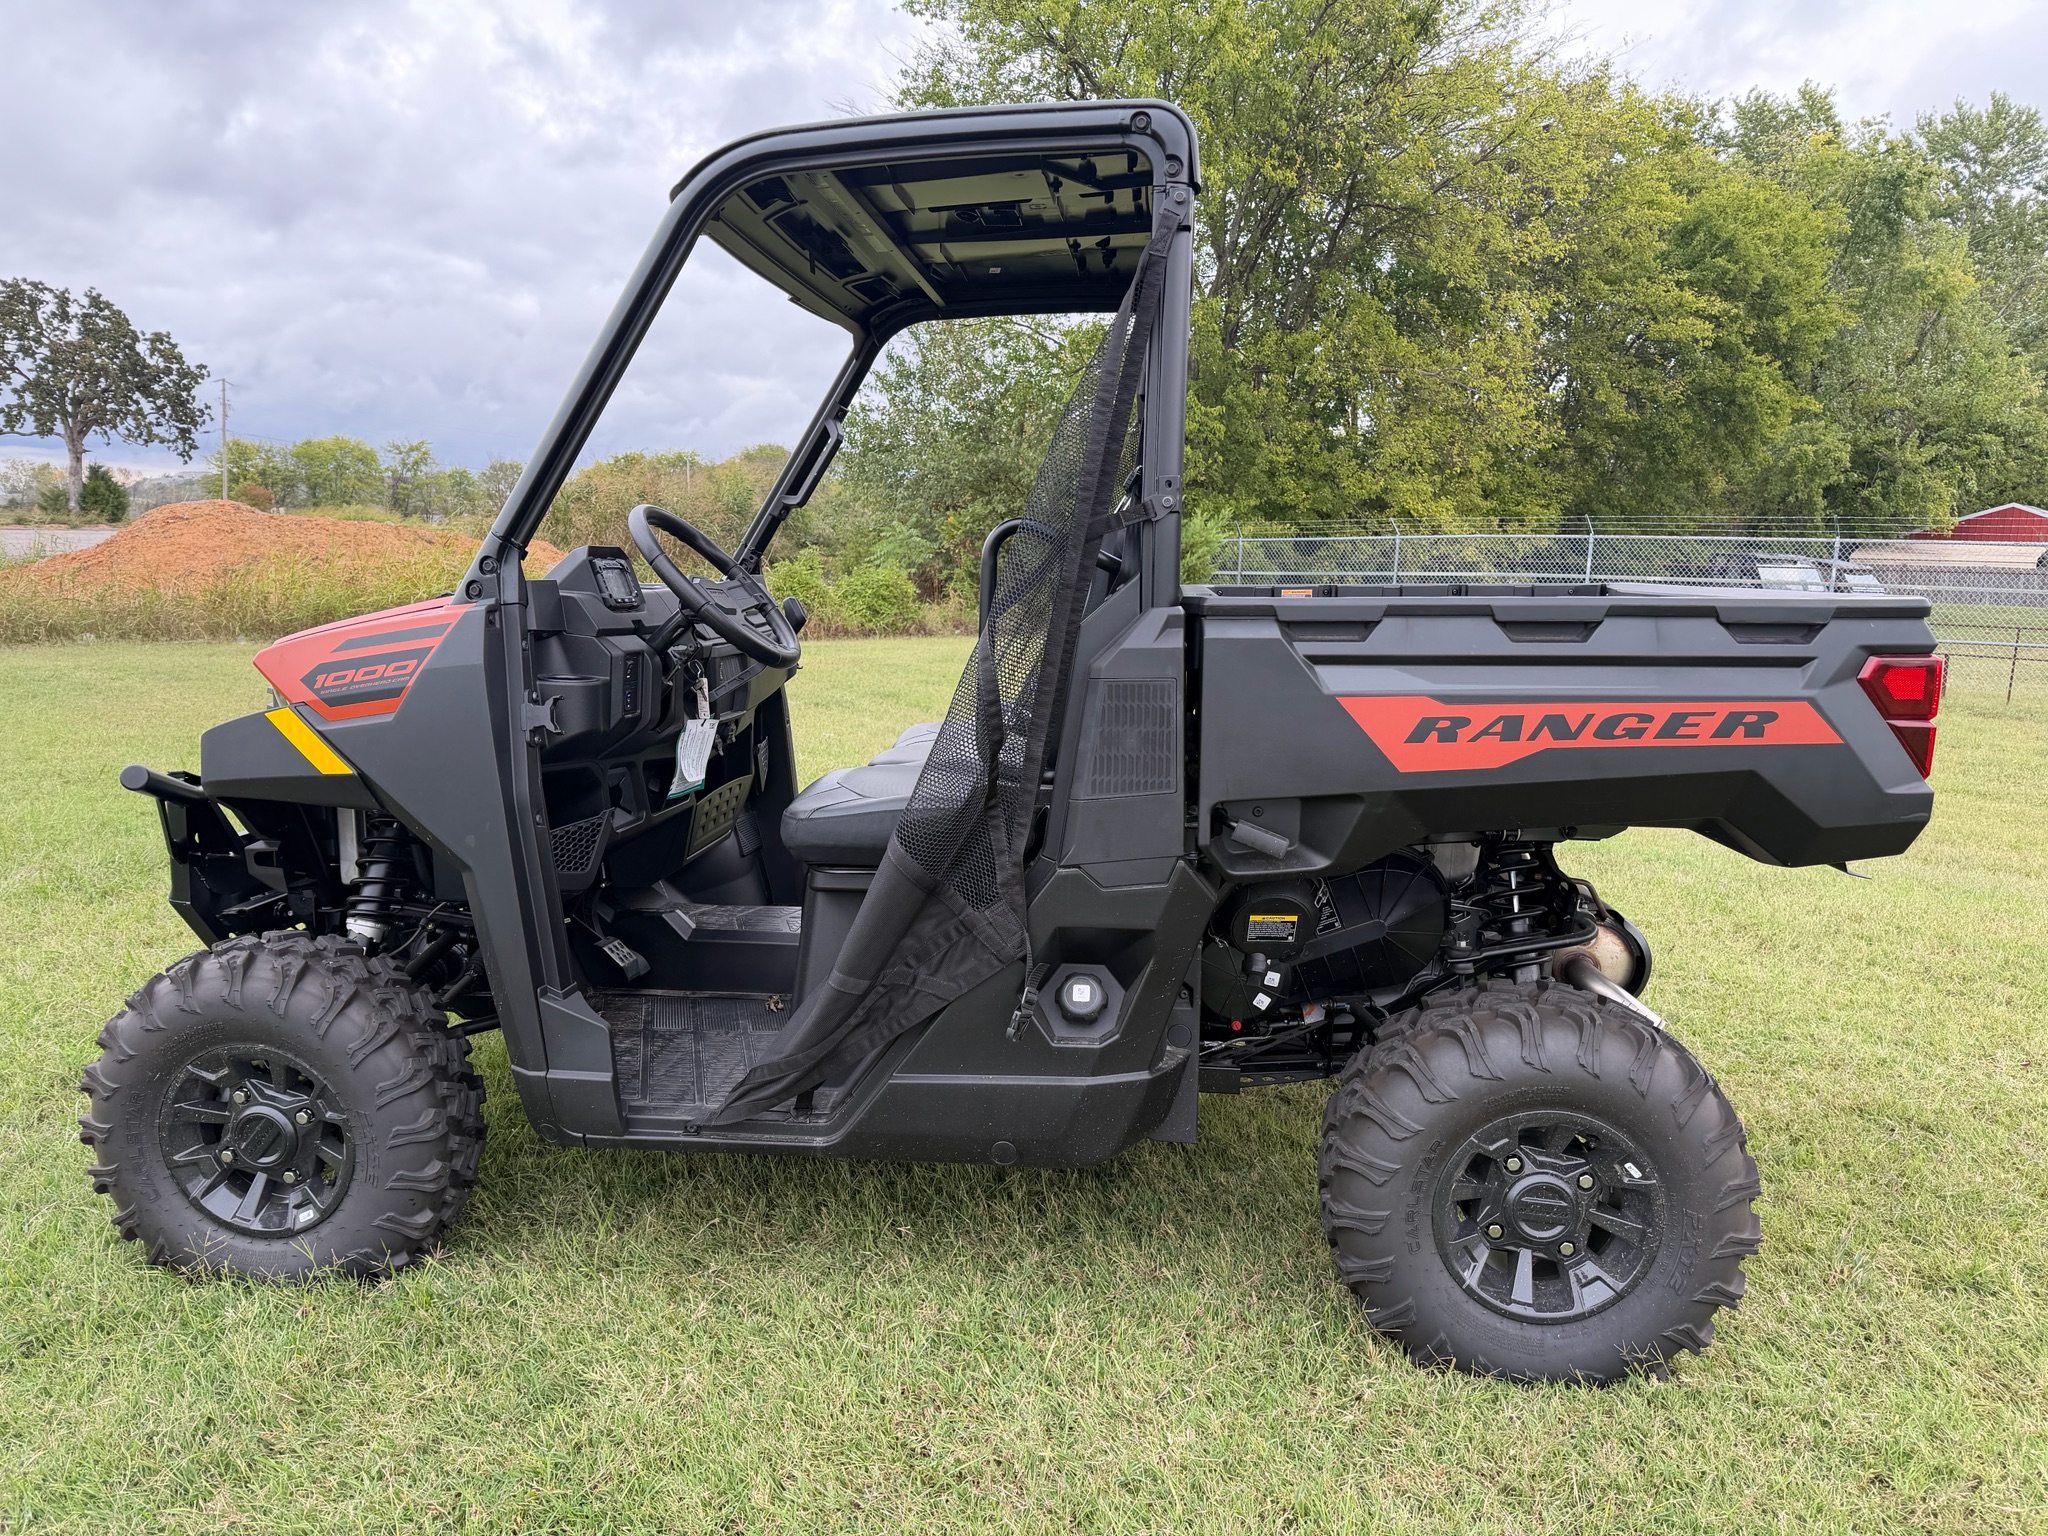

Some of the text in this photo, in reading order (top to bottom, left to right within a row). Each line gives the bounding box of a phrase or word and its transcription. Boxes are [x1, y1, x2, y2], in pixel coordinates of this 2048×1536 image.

[313, 659, 418, 689] 1000
[320, 686, 347, 695] SINGLE
[350, 679, 392, 690] OVERHEAD
[1403, 710, 1780, 743] RANGER
[126, 1091, 161, 1203] CARLSTAR
[1405, 1139, 1446, 1255] CARLSTAR
